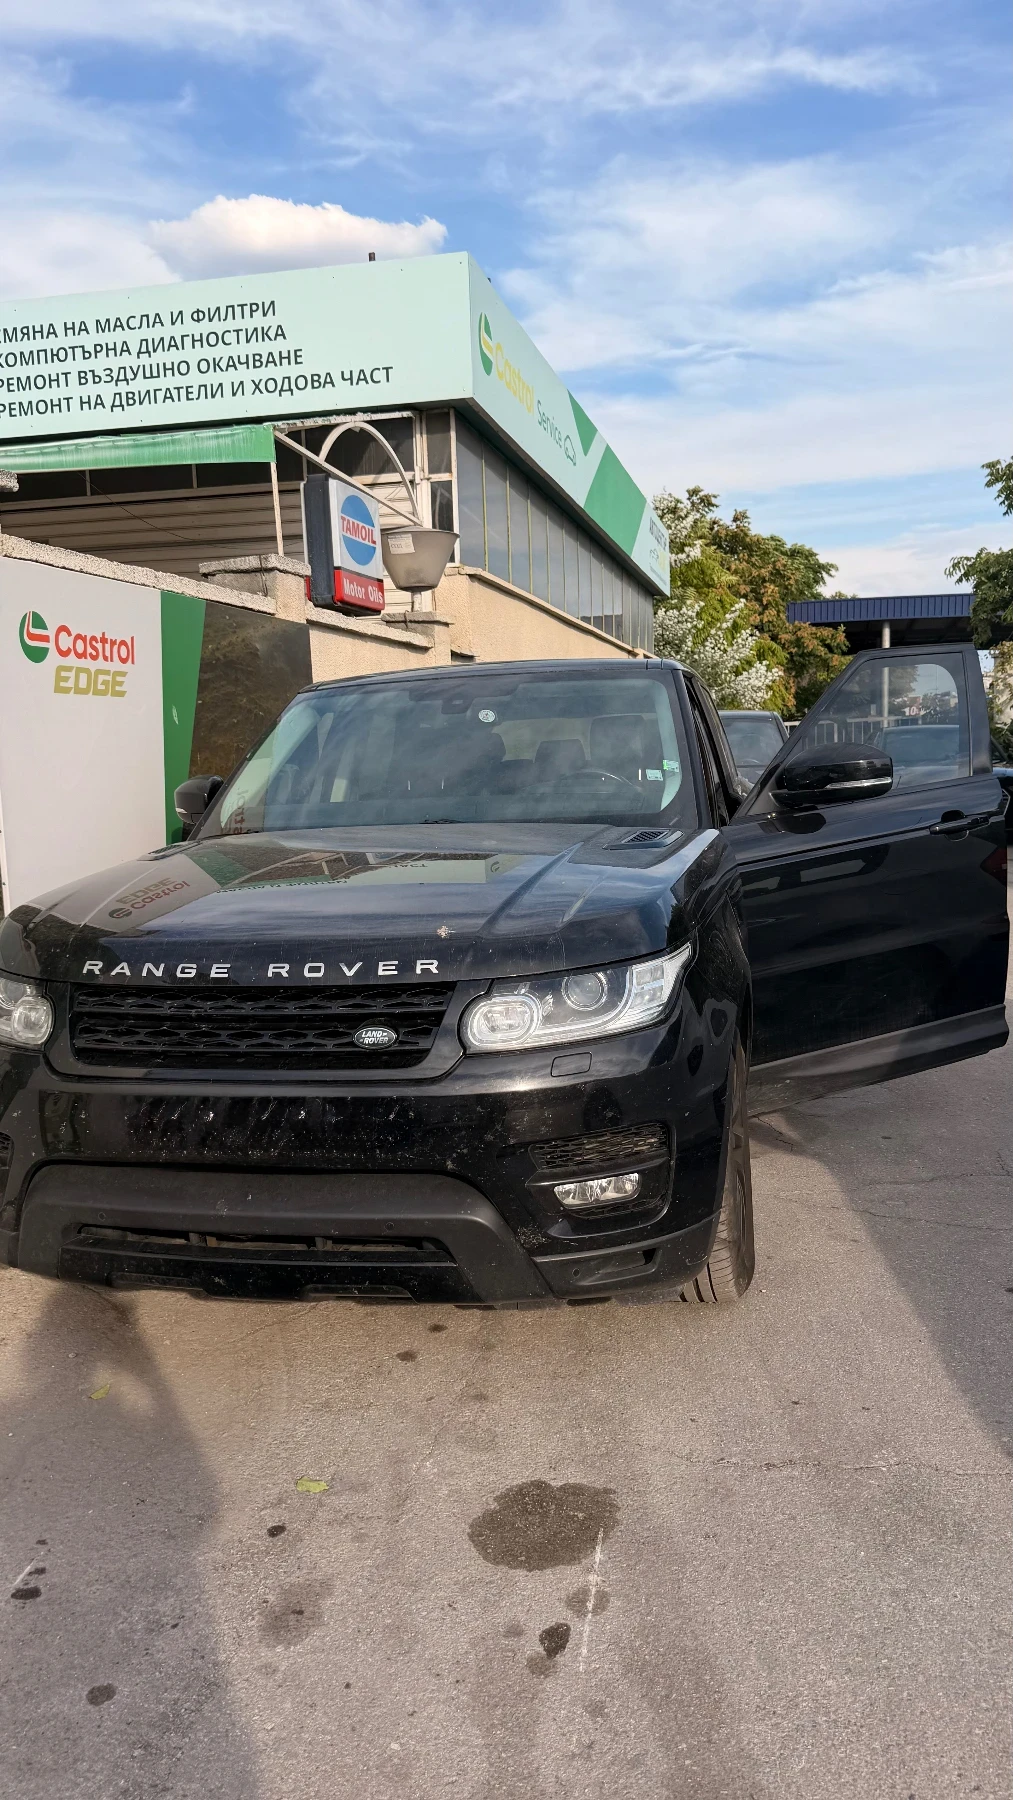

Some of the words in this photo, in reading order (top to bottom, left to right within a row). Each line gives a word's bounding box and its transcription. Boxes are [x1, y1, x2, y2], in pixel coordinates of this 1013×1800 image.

[0, 323, 59, 344] МЯНА
[63, 320, 91, 338] НА
[95, 312, 165, 334] МАСЛА
[170, 309, 184, 326] И
[190, 300, 277, 324] ФИЛТРИ
[137, 324, 287, 359] ДИАГНОСТИКА
[77, 360, 191, 387] ВЪЗДУШНО
[197, 348, 304, 375] ОКАЧВАНЕ
[79, 393, 106, 411] НА
[110, 382, 224, 413] ДВИГАТЕЛИ
[231, 380, 245, 398] И
[251, 372, 336, 398] ХОДОВА
[340, 366, 394, 387] ЧАСТ
[495, 341, 535, 416] Castrol
[537, 399, 562, 449] Service
[340, 515, 377, 545] TAMOIL
[343, 578, 366, 600] Motor
[368, 587, 383, 604] Oils
[54, 624, 135, 665] Castrol
[53, 664, 129, 698] EDGE
[82, 960, 231, 978] RANGE
[267, 959, 440, 979] ROVER
